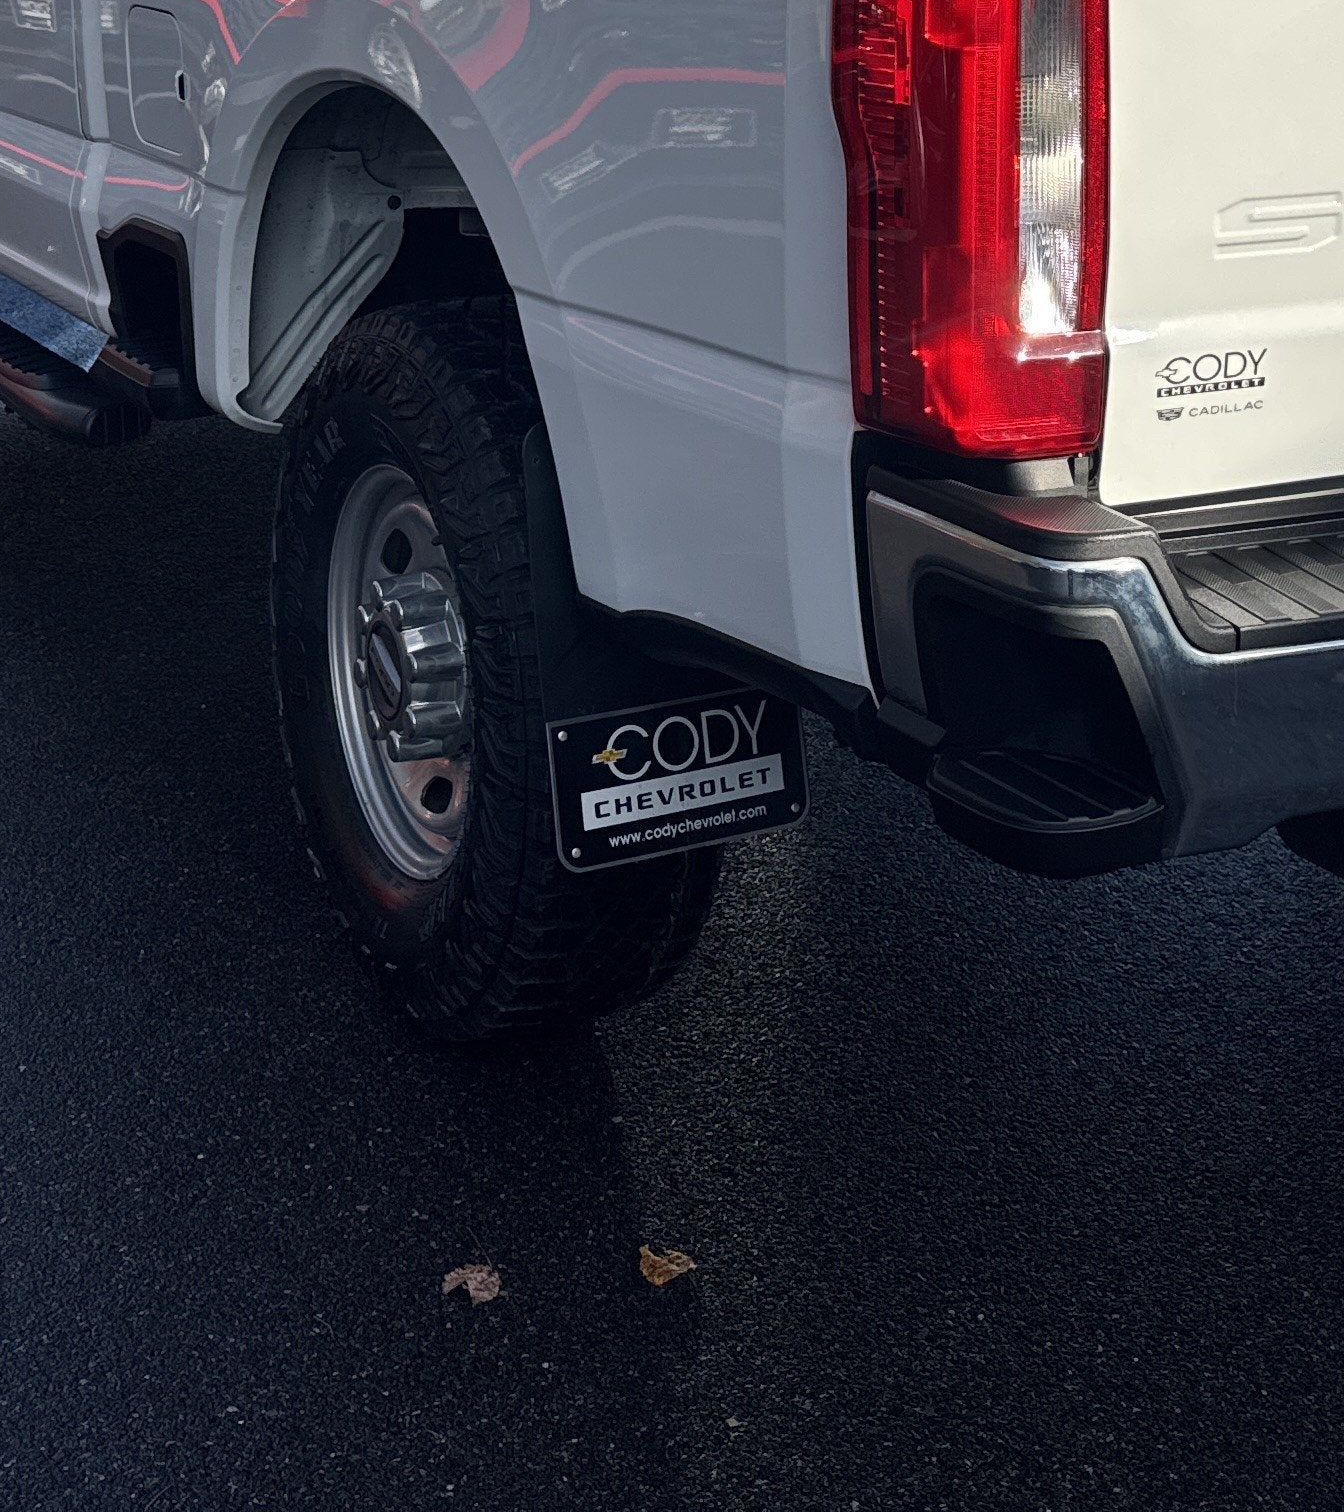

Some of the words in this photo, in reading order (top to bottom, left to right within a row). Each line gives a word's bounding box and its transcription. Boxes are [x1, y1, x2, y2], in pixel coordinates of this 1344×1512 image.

[1160, 347, 1268, 385] CODY
[1160, 377, 1262, 398] CHEVROLET
[1188, 399, 1264, 418] CADILLAC
[605, 699, 767, 781] CODY
[593, 766, 772, 819] CHEVROLET
[608, 803, 768, 849] www.codychevrolet.com
